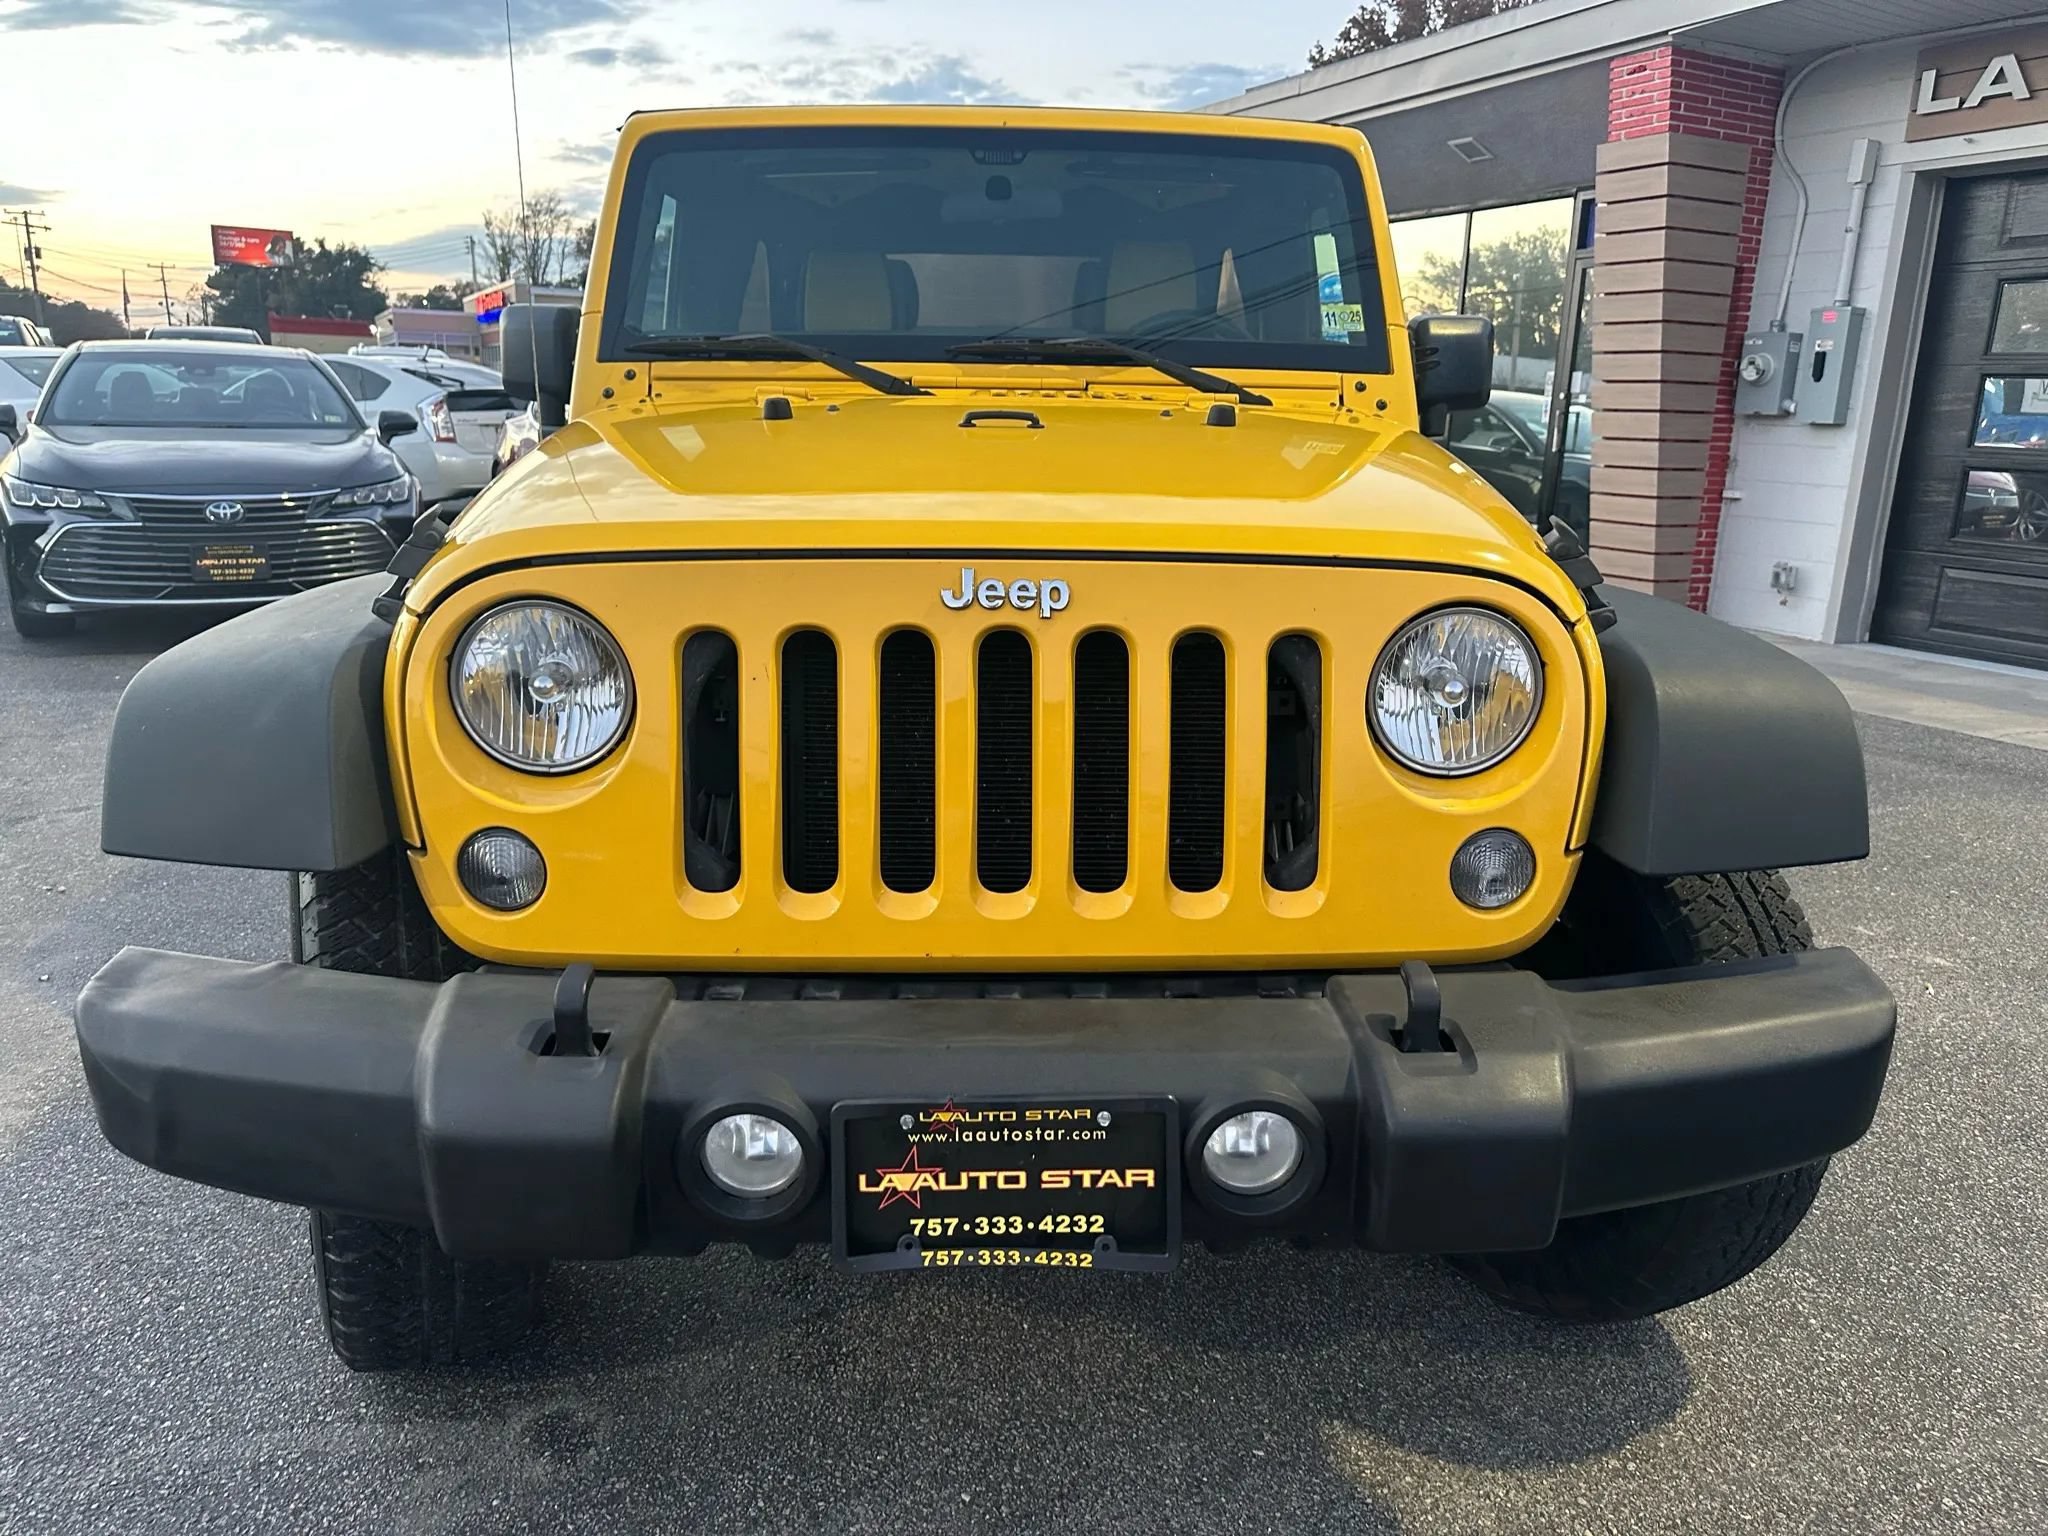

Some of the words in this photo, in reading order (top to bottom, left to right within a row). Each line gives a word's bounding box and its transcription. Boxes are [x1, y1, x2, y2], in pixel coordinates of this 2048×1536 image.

[1916, 53, 2031, 115] LA
[1324, 311, 1338, 327] 11
[1350, 310, 1362, 322] 25
[940, 567, 1071, 619] Jeep
[1025, 1108, 1092, 1121] STAR
[908, 1127, 1107, 1143] www.laautostar.com
[1040, 1168, 1156, 1190] STAR
